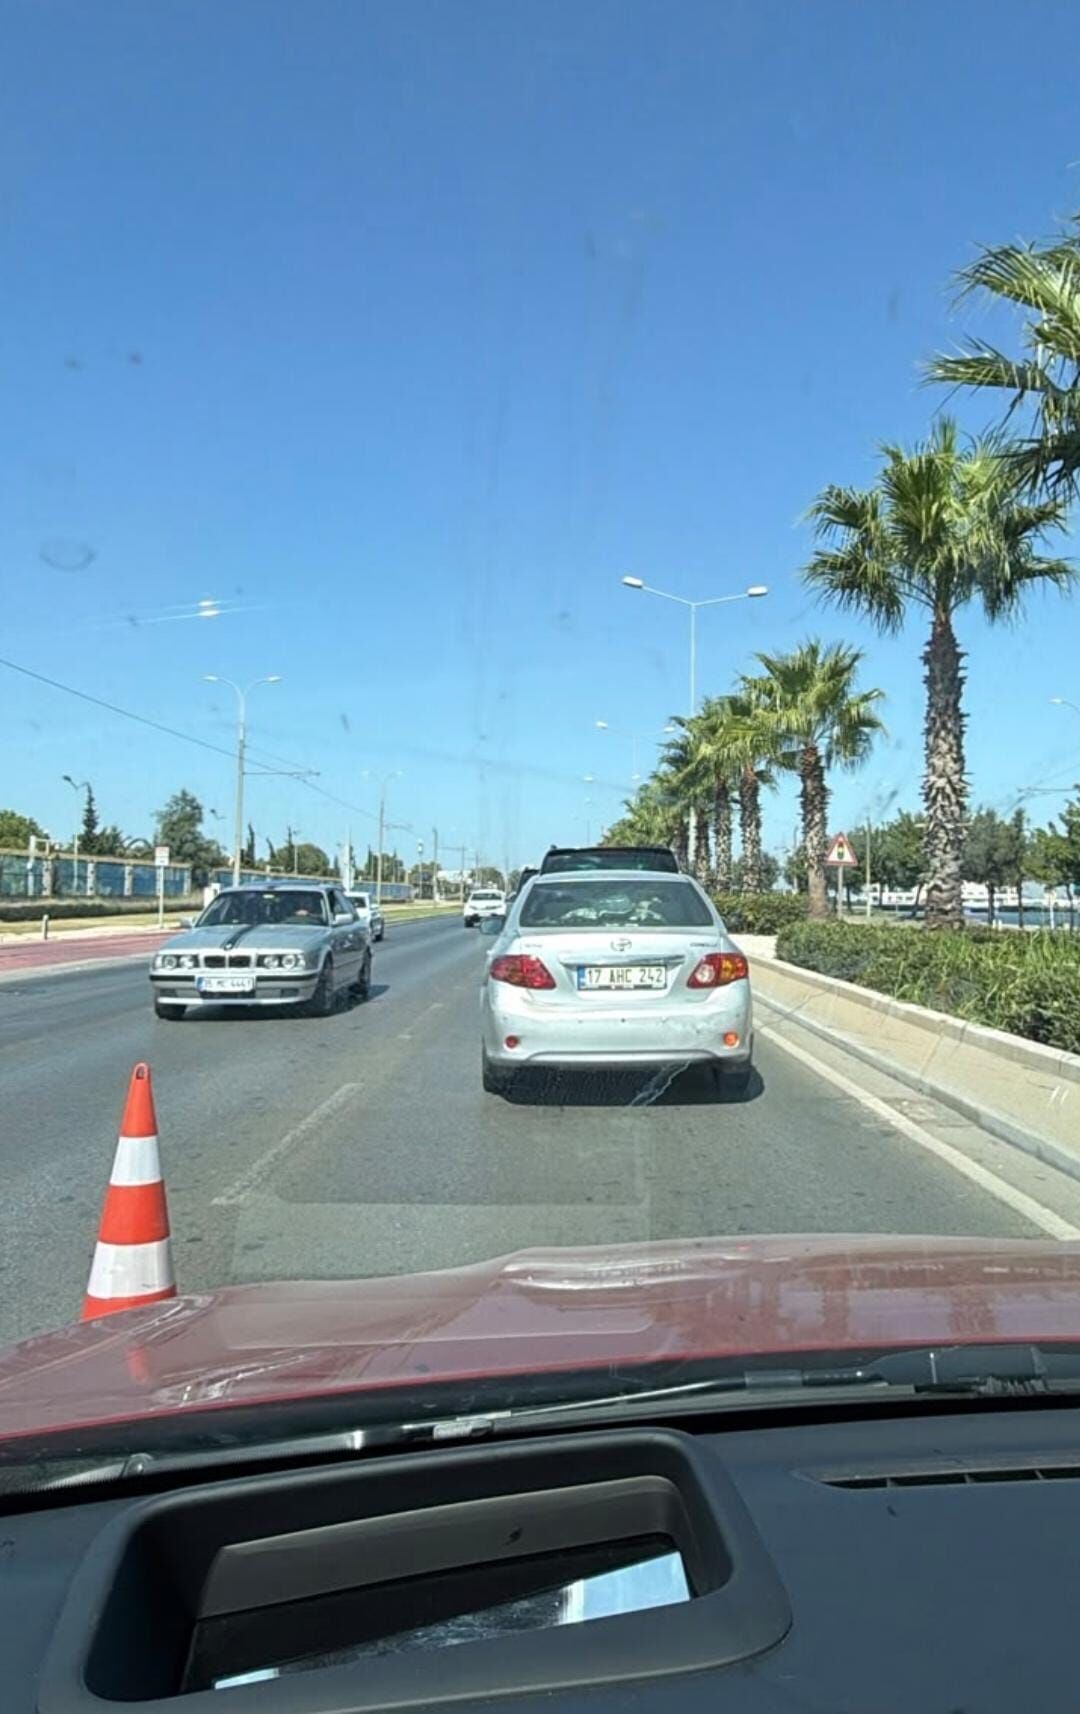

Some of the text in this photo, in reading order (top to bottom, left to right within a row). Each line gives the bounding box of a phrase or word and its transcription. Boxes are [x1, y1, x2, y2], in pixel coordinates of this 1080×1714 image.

[588, 968, 663, 983] 17 AHC 242
